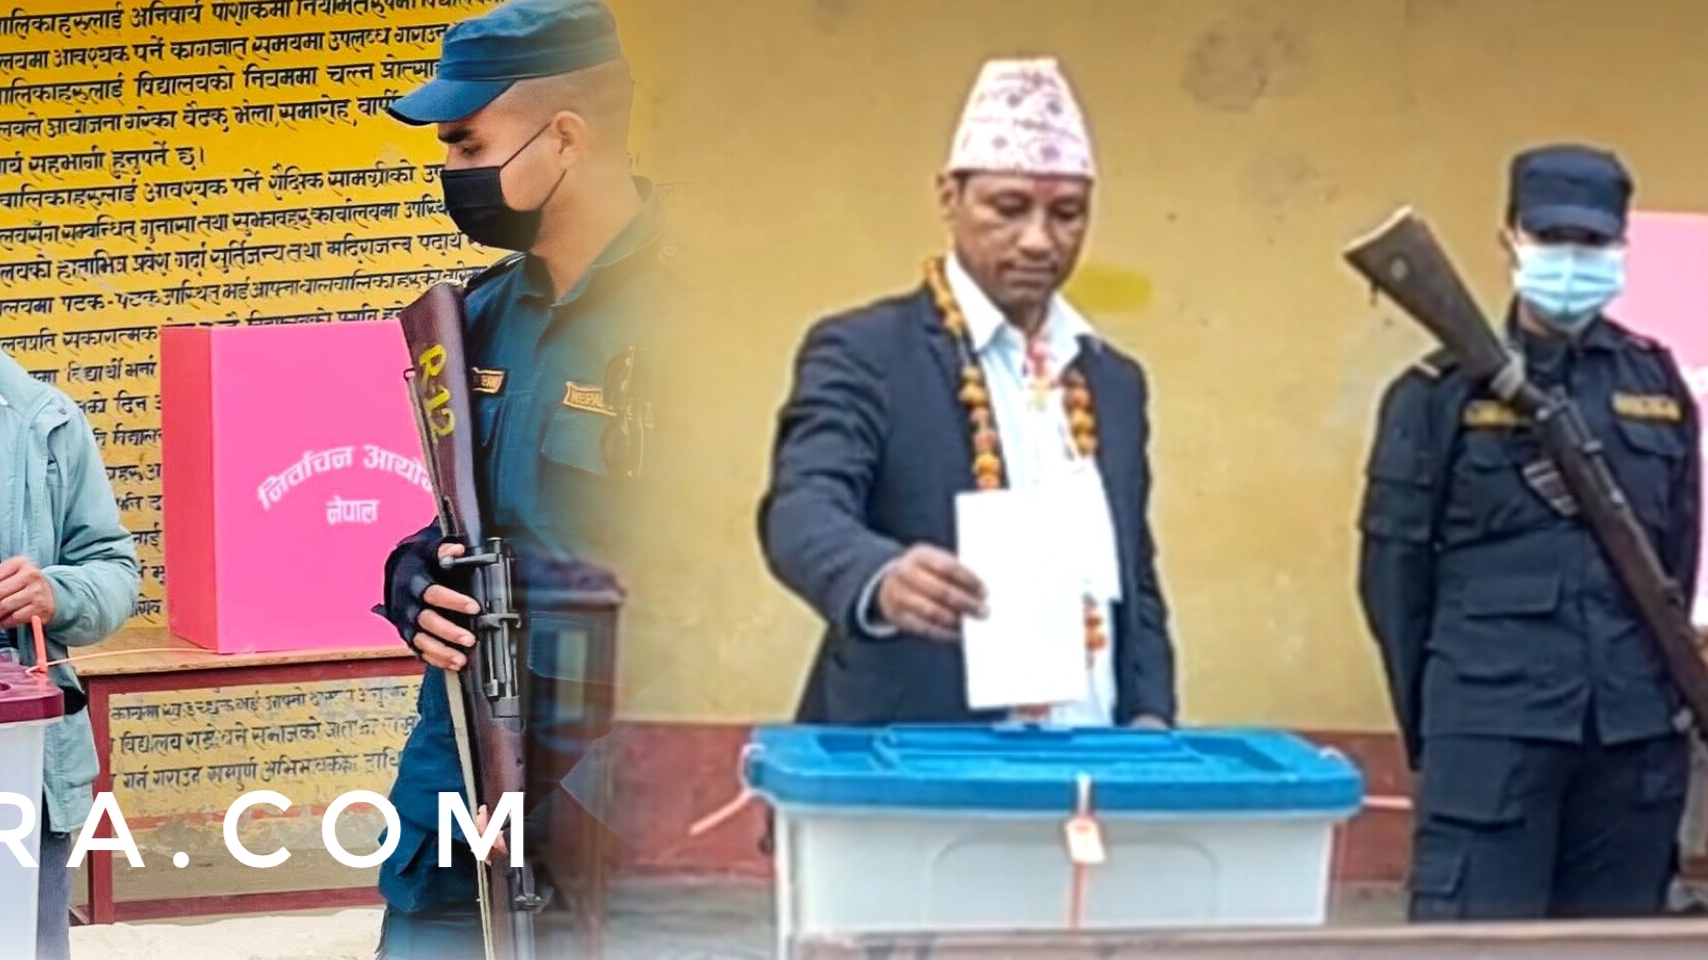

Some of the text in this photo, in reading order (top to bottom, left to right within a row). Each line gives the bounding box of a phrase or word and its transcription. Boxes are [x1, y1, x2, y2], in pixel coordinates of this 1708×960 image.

[170, 37, 249, 61] कागजात
[251, 32, 325, 61] समयमा
[257, 446, 355, 511] निर्वाचन
[325, 495, 380, 524] नेपाल
